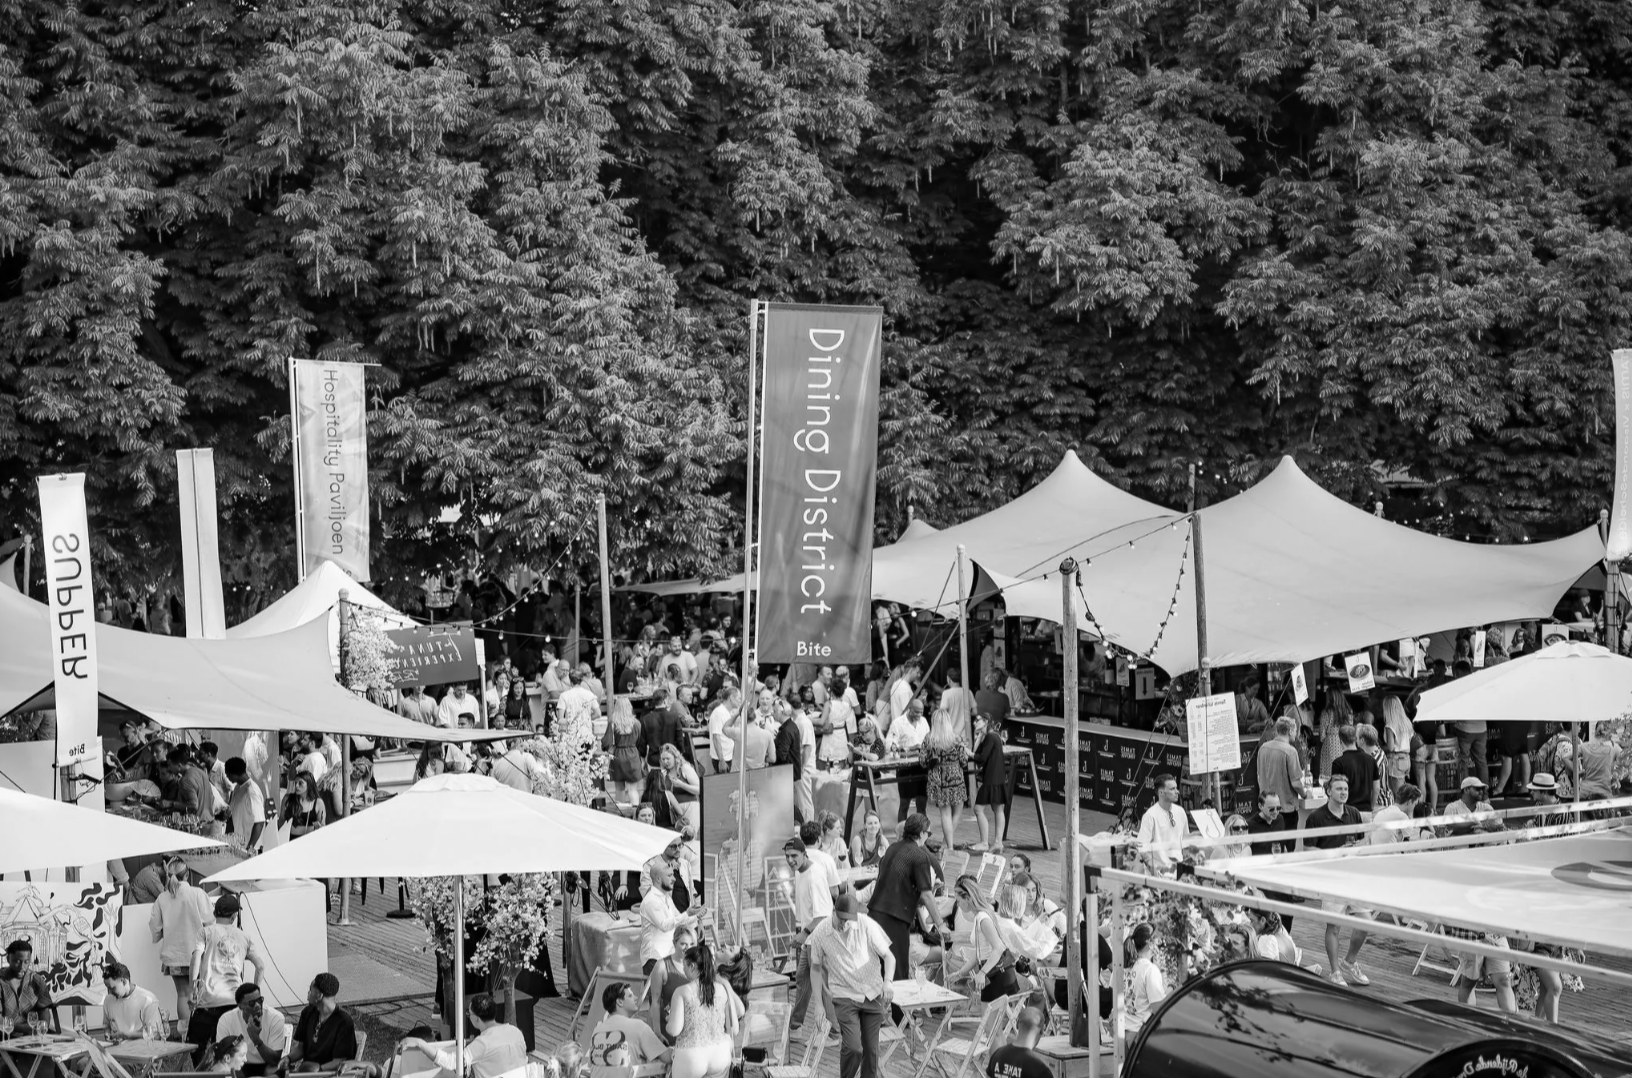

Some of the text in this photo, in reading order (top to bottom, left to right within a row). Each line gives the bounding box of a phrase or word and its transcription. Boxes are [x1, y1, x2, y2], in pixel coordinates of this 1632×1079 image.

[320, 369, 347, 555] Hospitality Paviljoen
[793, 328, 845, 614] Dining District
[796, 641, 832, 658] Bite
